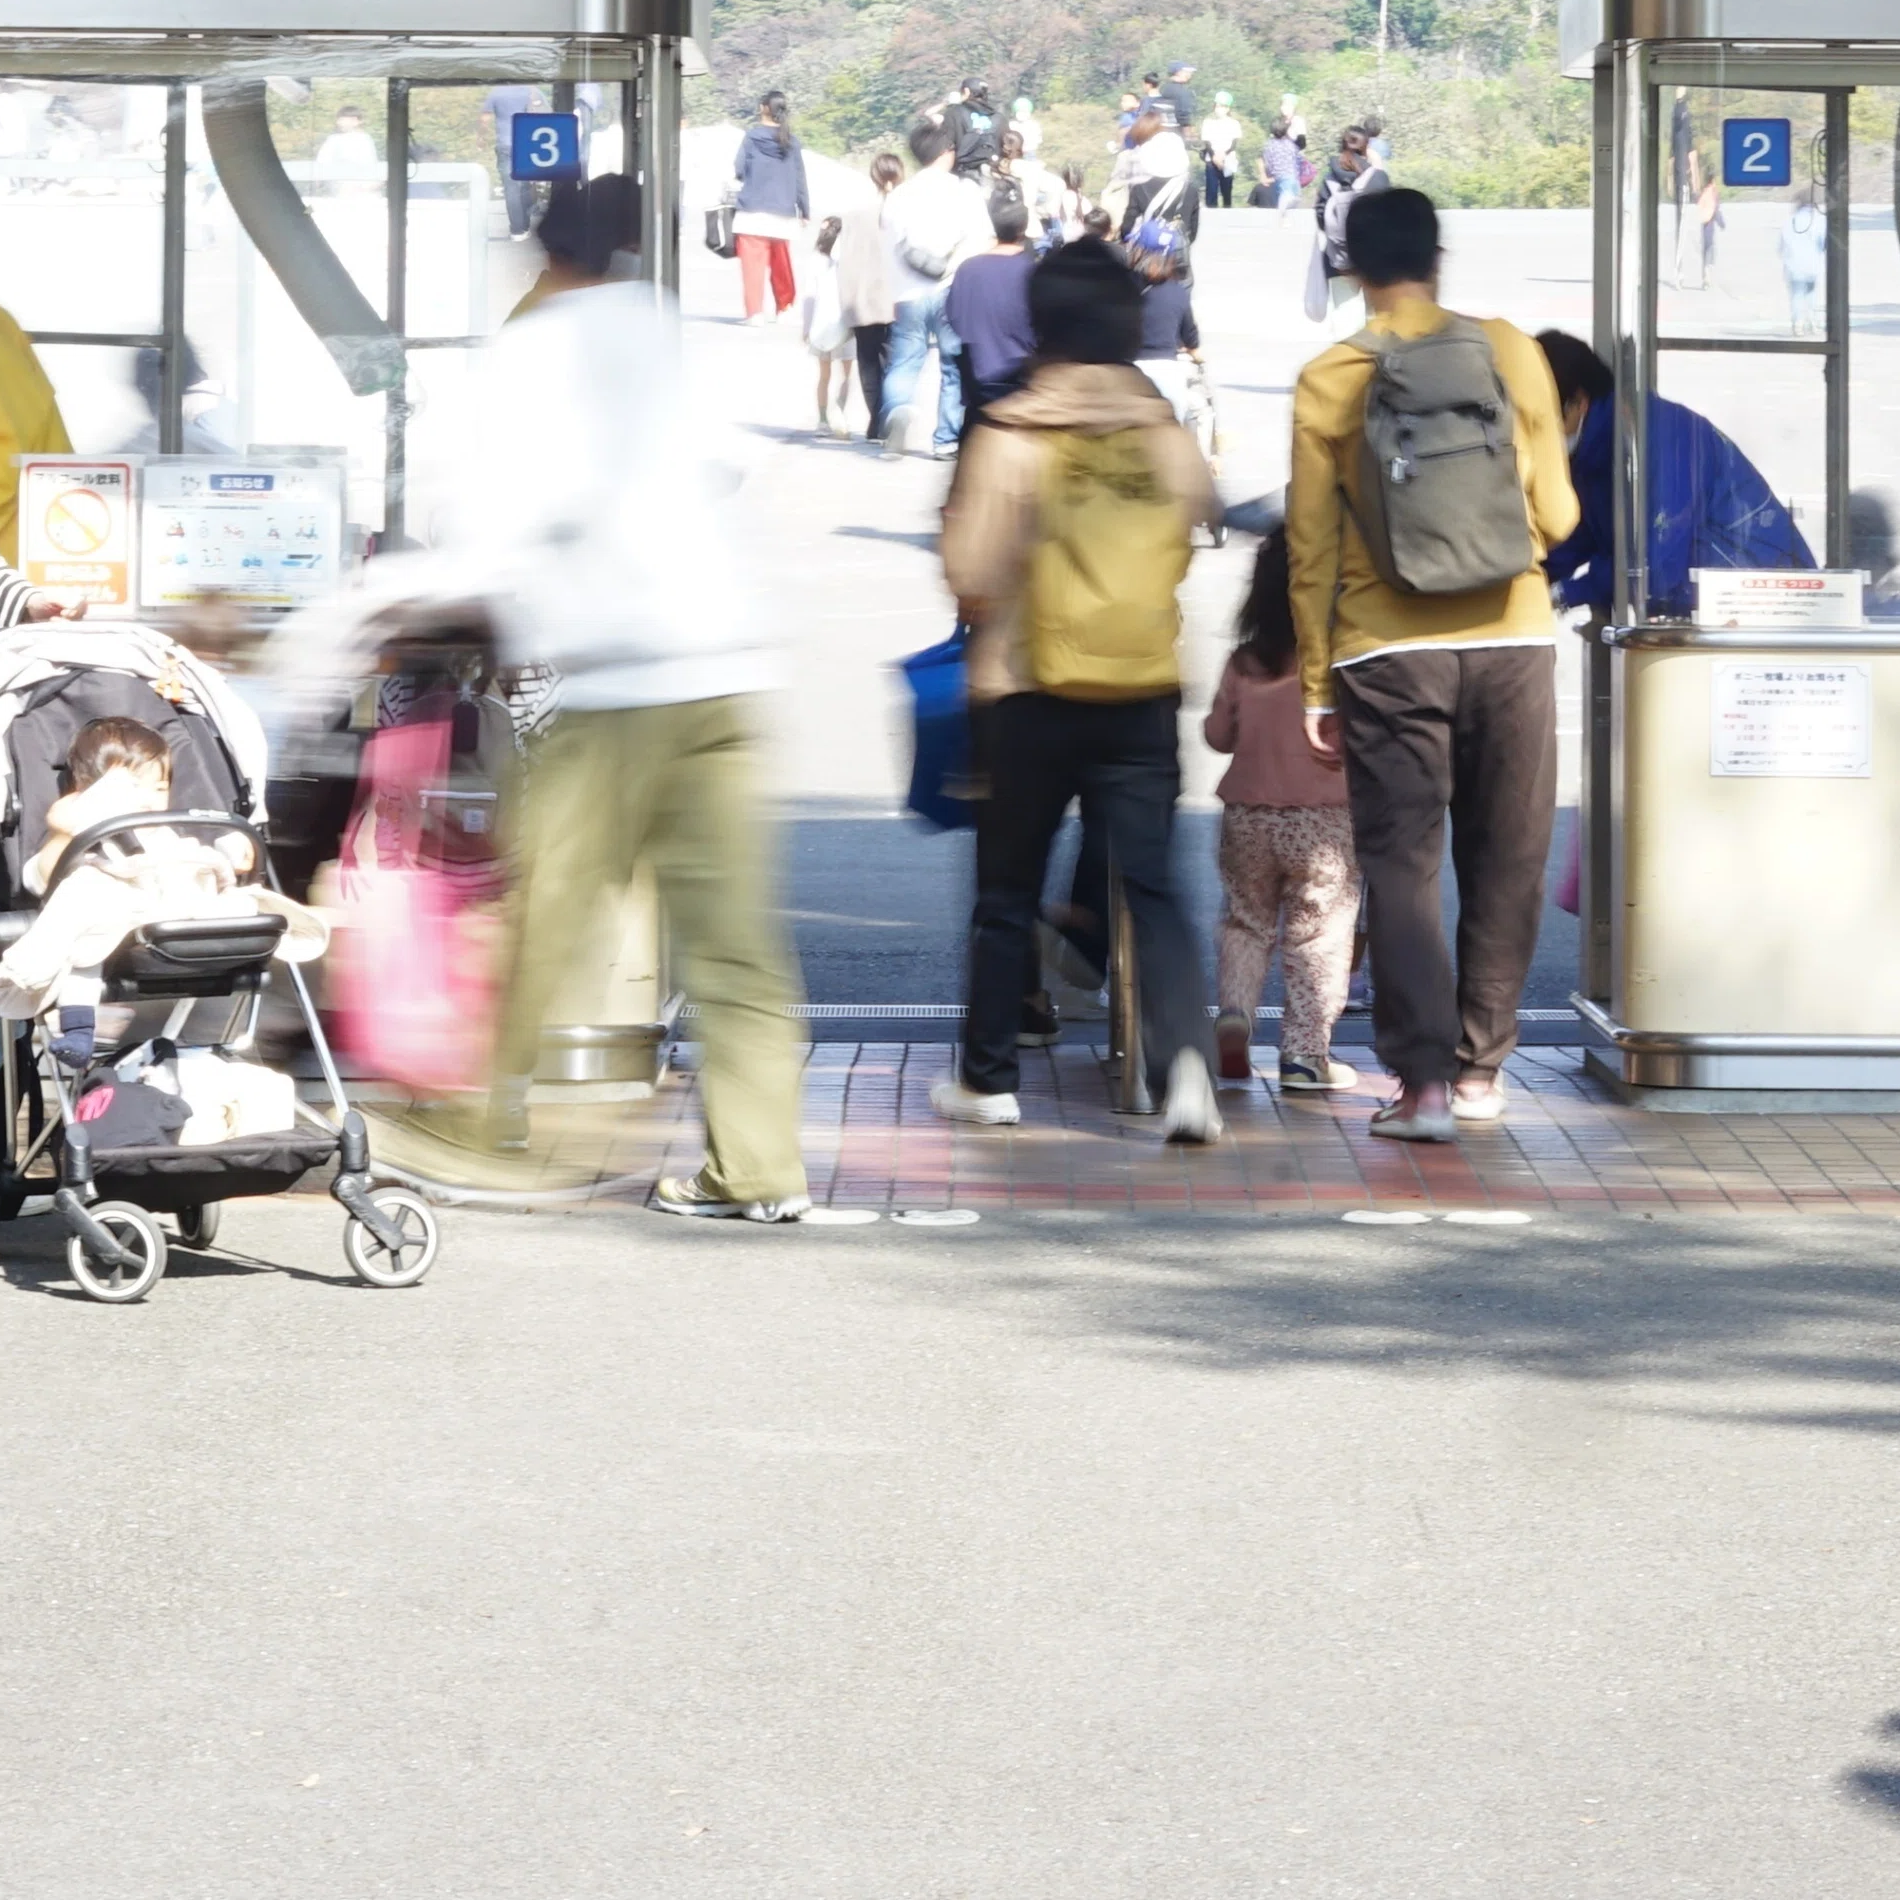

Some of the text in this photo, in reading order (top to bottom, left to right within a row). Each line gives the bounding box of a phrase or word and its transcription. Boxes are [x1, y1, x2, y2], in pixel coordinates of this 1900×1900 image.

[529, 125, 562, 167] 3
[1740, 131, 1773, 174] 2
[35, 472, 121, 487] アルコール飲料
